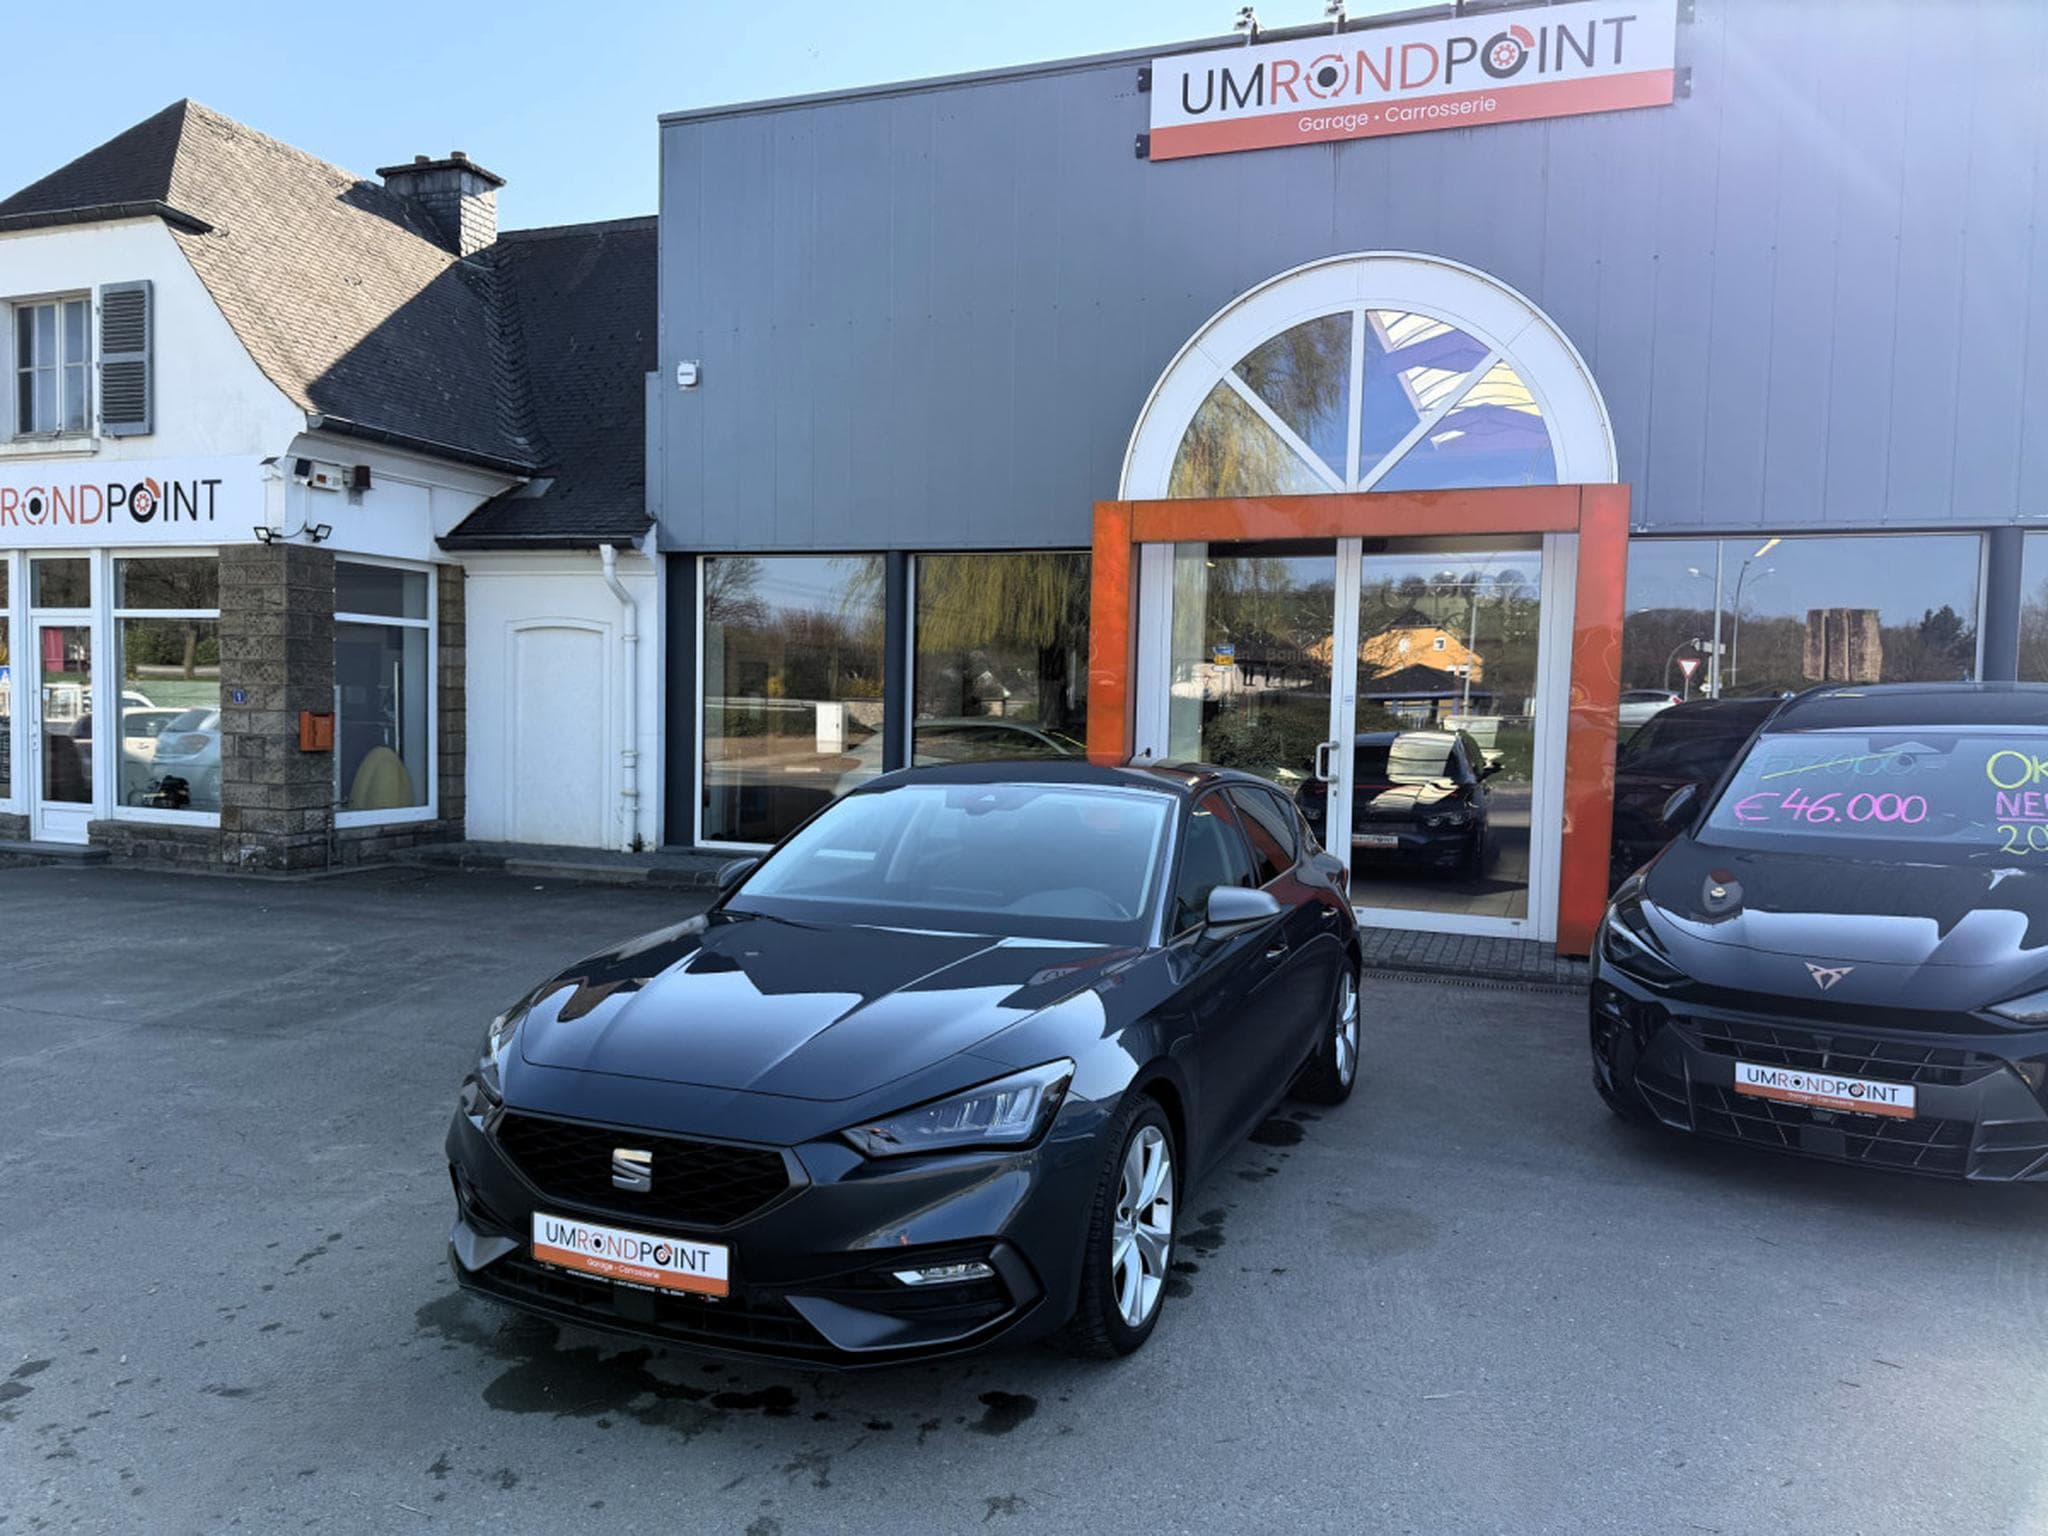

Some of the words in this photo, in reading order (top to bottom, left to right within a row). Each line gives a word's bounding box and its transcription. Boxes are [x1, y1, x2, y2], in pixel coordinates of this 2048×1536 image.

[1298, 112, 1368, 132] Garage
[1385, 96, 1497, 122] Carrosserie
[1996, 791, 2048, 816] NE
